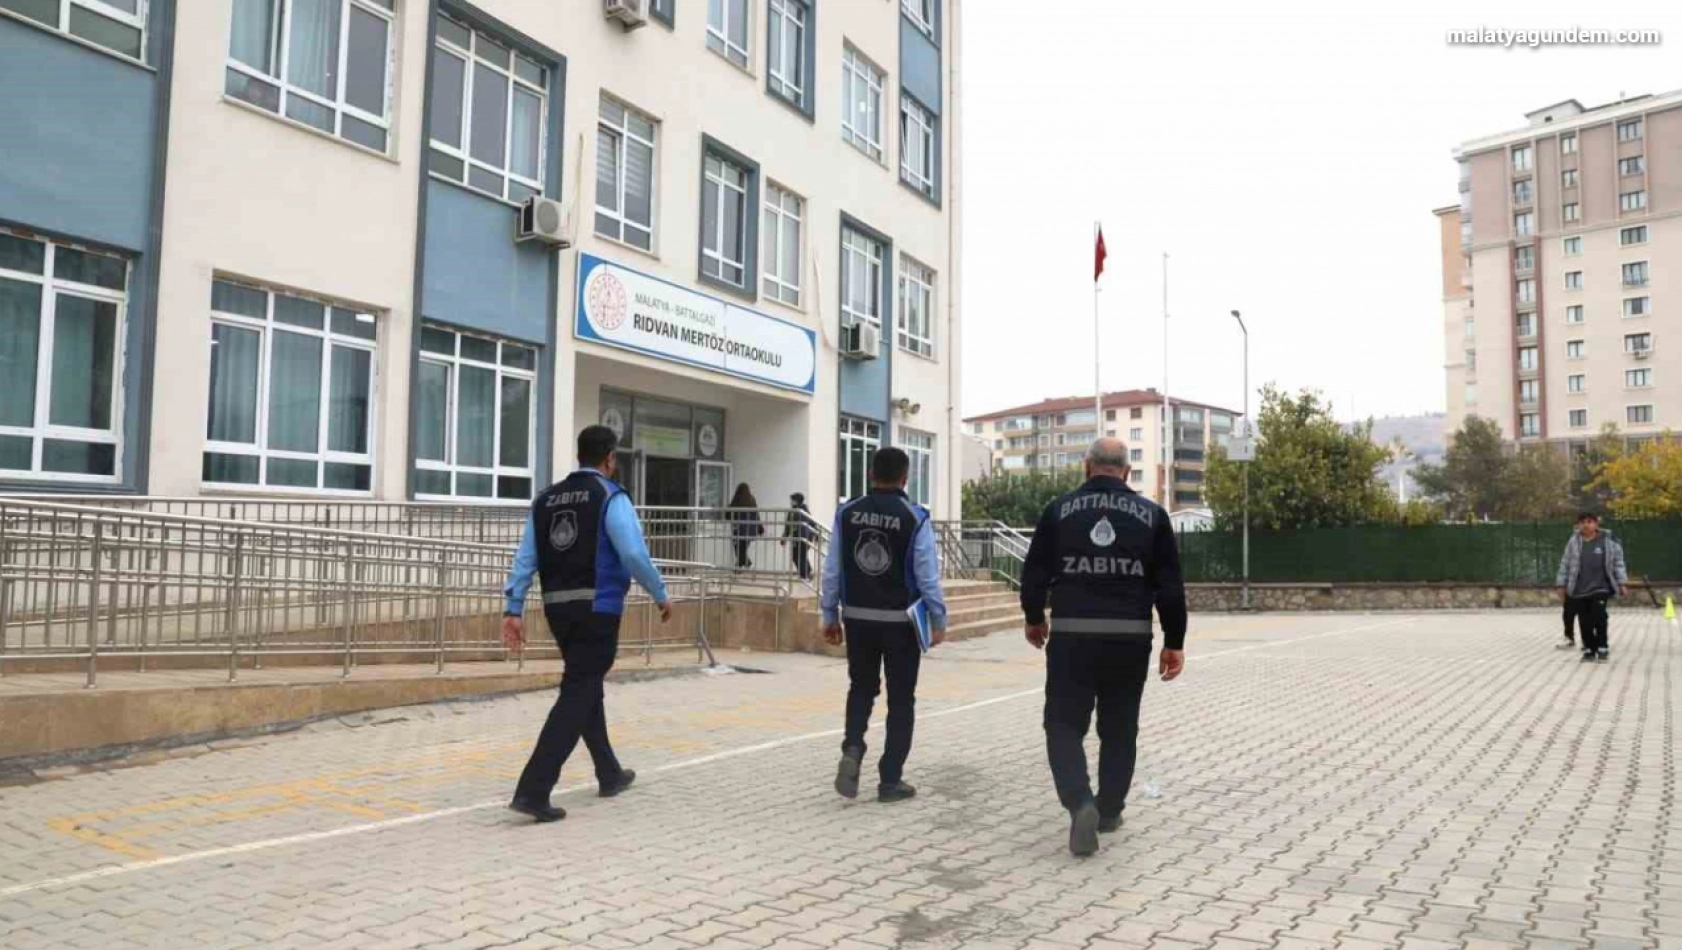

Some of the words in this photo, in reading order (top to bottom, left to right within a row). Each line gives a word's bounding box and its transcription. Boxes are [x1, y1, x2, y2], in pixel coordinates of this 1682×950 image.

[635, 292, 670, 311] MALATYA
[633, 313, 678, 339] RIDVAN
[680, 326, 725, 352] MERTÖZ
[726, 340, 781, 367] ORTAOKULU
[545, 490, 589, 507] ZABITA
[850, 511, 901, 530] ZABITA
[1062, 556, 1145, 576] ZABITA
